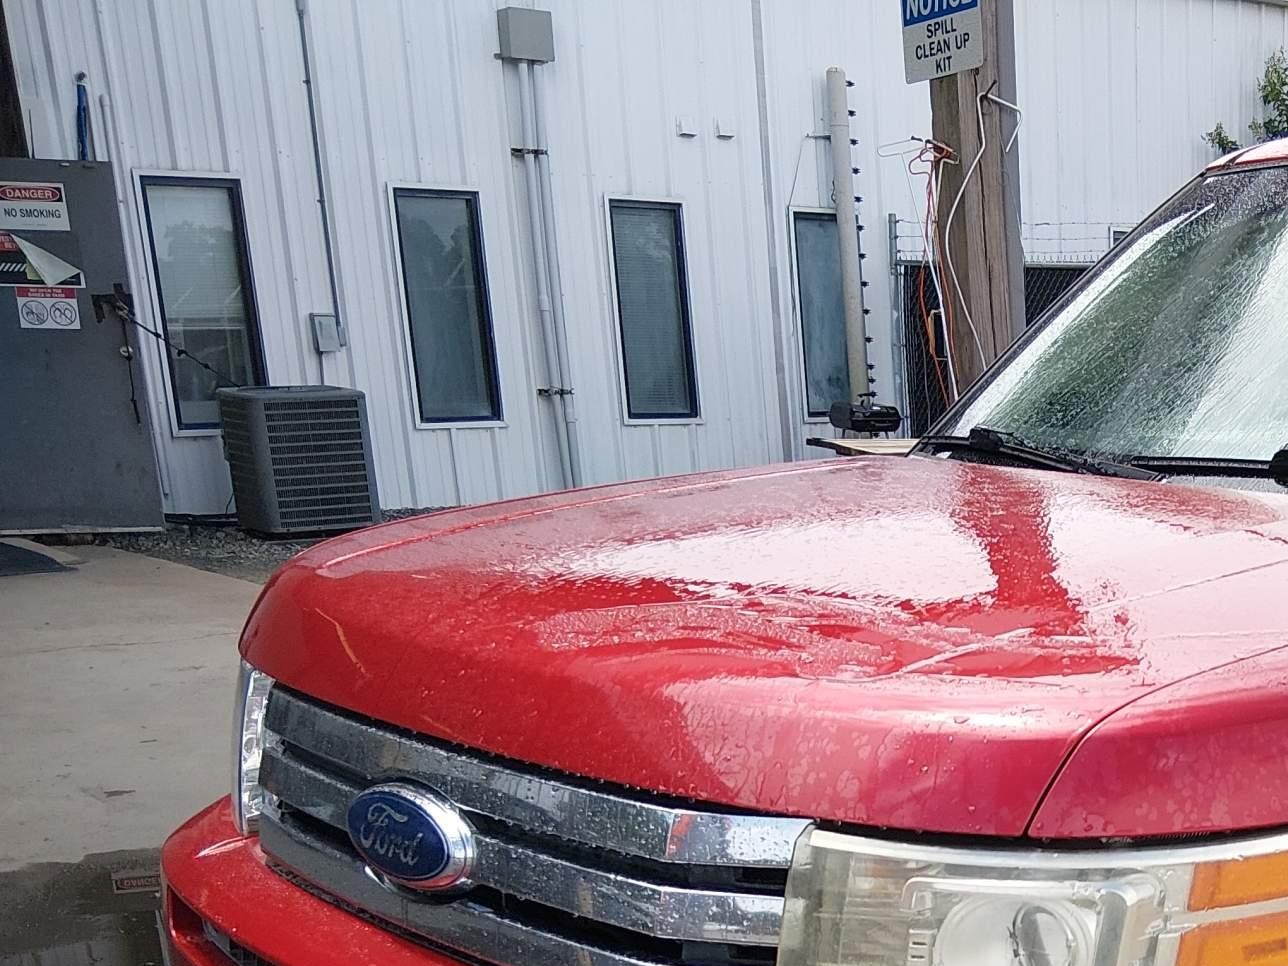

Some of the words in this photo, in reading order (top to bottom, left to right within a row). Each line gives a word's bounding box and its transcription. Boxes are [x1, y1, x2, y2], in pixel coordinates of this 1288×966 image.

[926, 17, 957, 39] SPILL
[915, 37, 951, 60] CLEAN
[955, 32, 970, 50] UP
[935, 56, 952, 74] KIT
[6, 188, 53, 199] DANGER
[3, 207, 18, 218] NO
[19, 208, 62, 219] SMOKING
[360, 802, 424, 866] Ford
